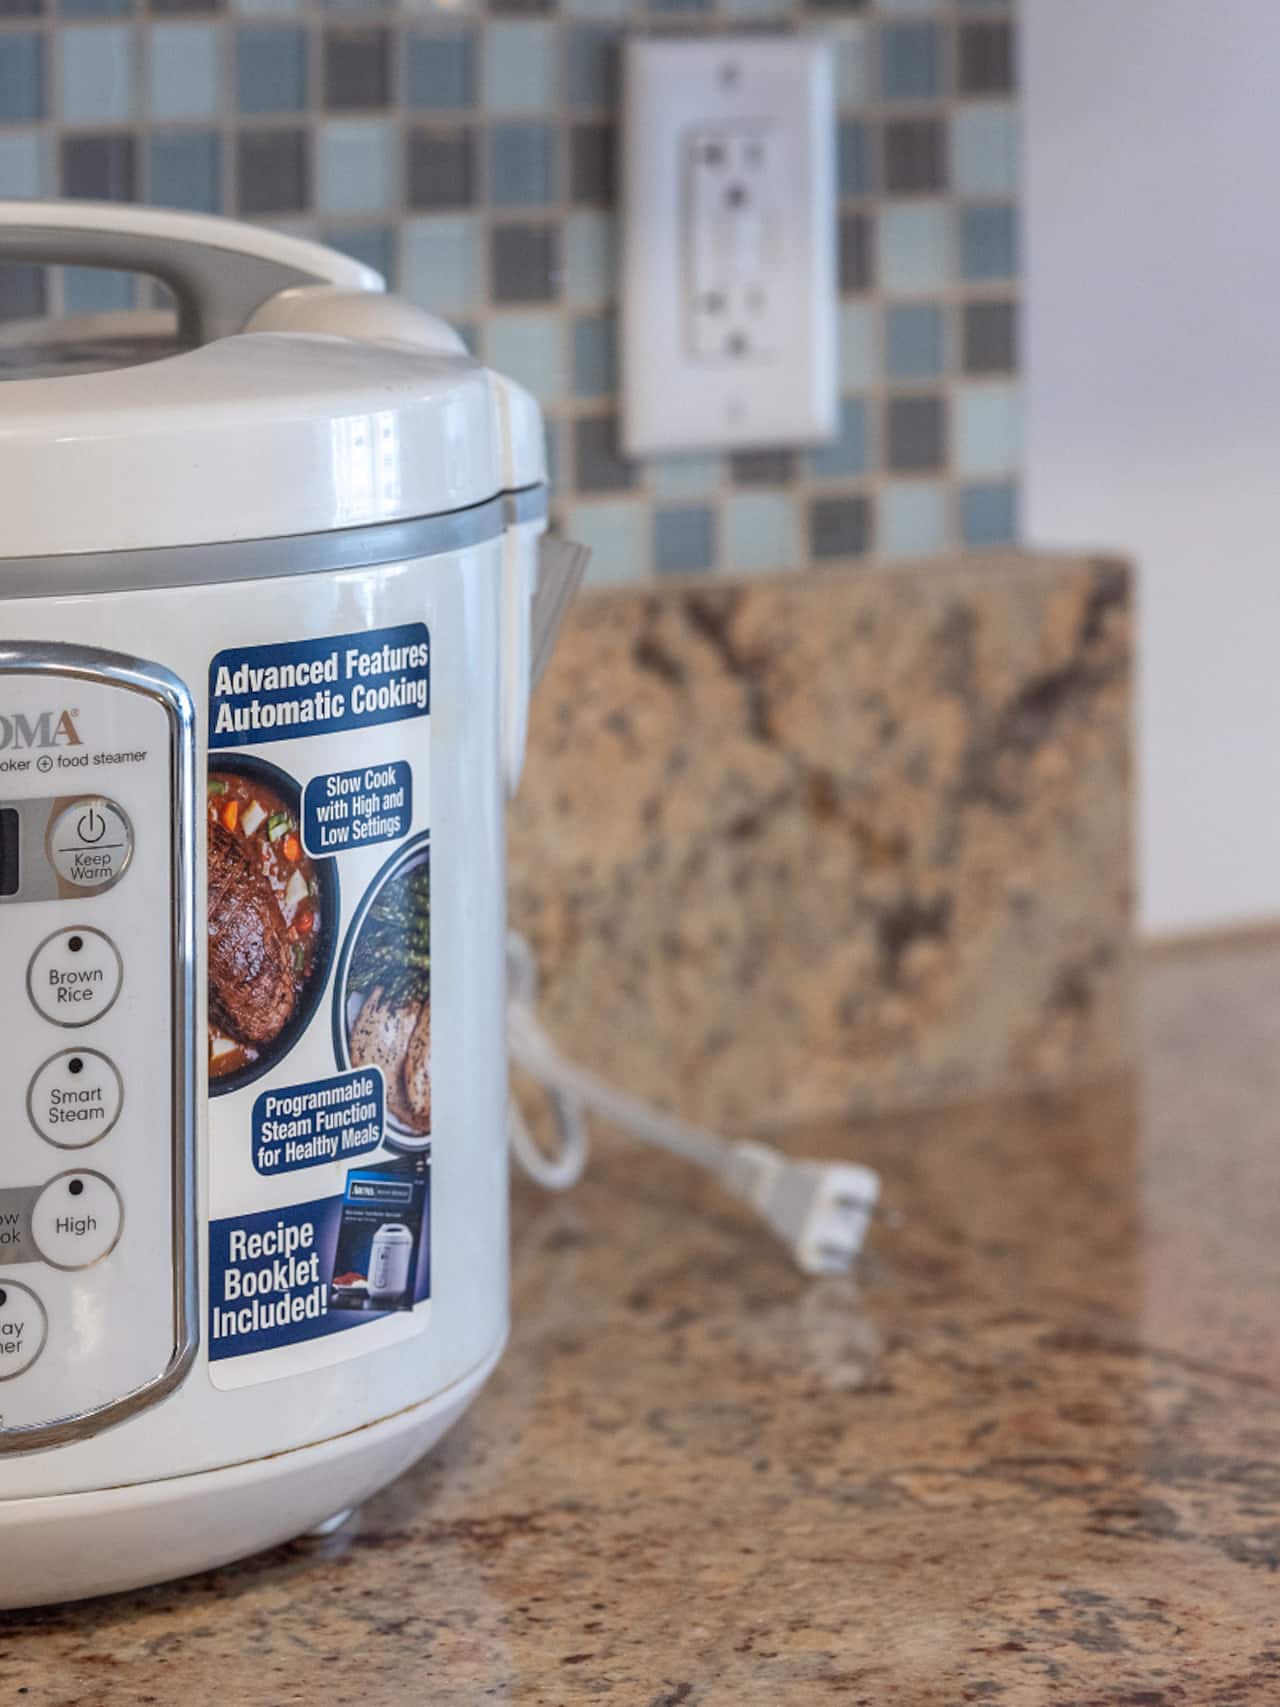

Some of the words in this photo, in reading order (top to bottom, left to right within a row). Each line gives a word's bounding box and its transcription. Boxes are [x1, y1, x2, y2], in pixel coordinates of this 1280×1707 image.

[215, 652, 338, 697] Advanced
[346, 643, 428, 679] Features
[215, 692, 345, 733] Automatic
[352, 677, 427, 714] Cooking
[57, 754, 89, 768] food
[92, 750, 147, 766] steamer
[327, 775, 361, 797] Slow
[365, 766, 396, 787] Cook
[316, 801, 348, 822] with
[352, 792, 380, 817] High
[383, 788, 404, 809] and
[320, 825, 348, 846] Low
[352, 815, 400, 839] Settings
[70, 865, 113, 880] Warm
[74, 853, 112, 867] Keep
[49, 969, 104, 985] Brown
[57, 987, 94, 1003] Rice
[50, 1088, 103, 1105] Smart
[265, 1077, 374, 1118] Programmable
[48, 1106, 104, 1124] Steam
[261, 1119, 312, 1144] Steam
[316, 1102, 376, 1133] Function
[257, 1147, 282, 1168] for
[285, 1136, 337, 1164] Healthy
[341, 1123, 380, 1147] Meals
[56, 1216, 97, 1236] High
[229, 1222, 315, 1263] Recipe
[224, 1253, 320, 1301] Booklet
[212, 1284, 328, 1338] Included!
